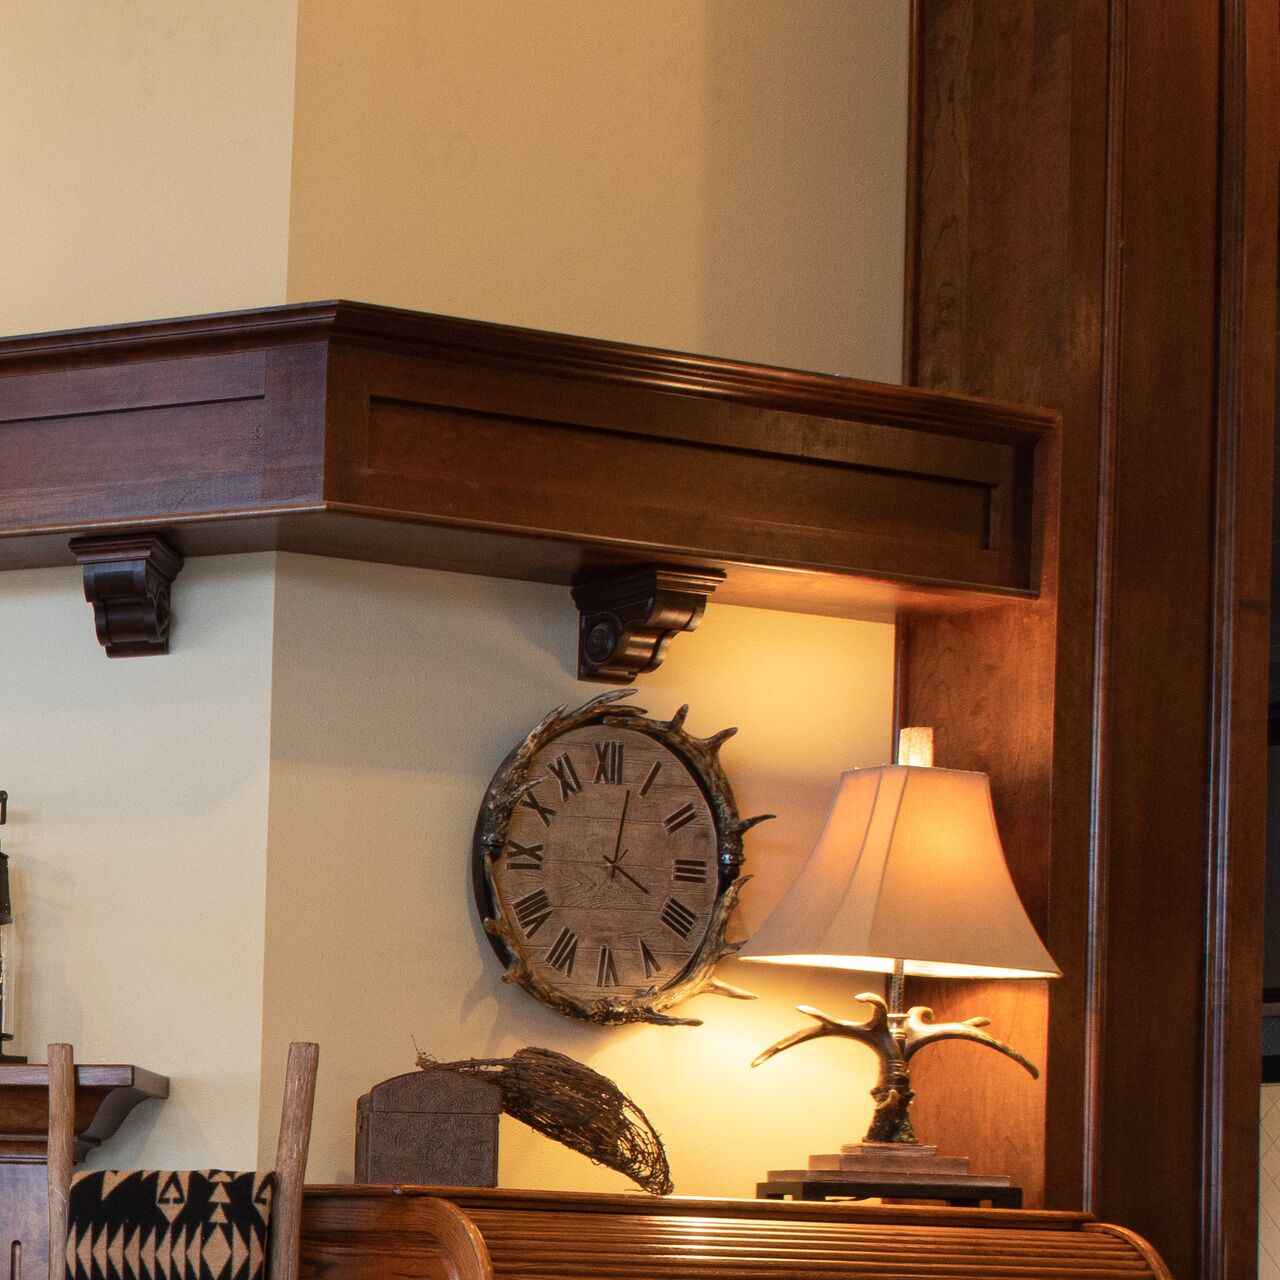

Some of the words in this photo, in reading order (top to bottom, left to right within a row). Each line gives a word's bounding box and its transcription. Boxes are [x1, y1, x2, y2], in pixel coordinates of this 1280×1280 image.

[546, 752, 582, 802] XI
[593, 740, 623, 785] XII
[639, 760, 662, 798] I
[519, 789, 557, 828] X
[662, 802, 697, 836] II
[506, 839, 543, 870] IX
[673, 859, 707, 883] III
[511, 888, 553, 940] VIII
[659, 896, 697, 941] IIII
[545, 926, 578, 978] VII
[597, 944, 620, 987] VI
[638, 936, 661, 979] V
